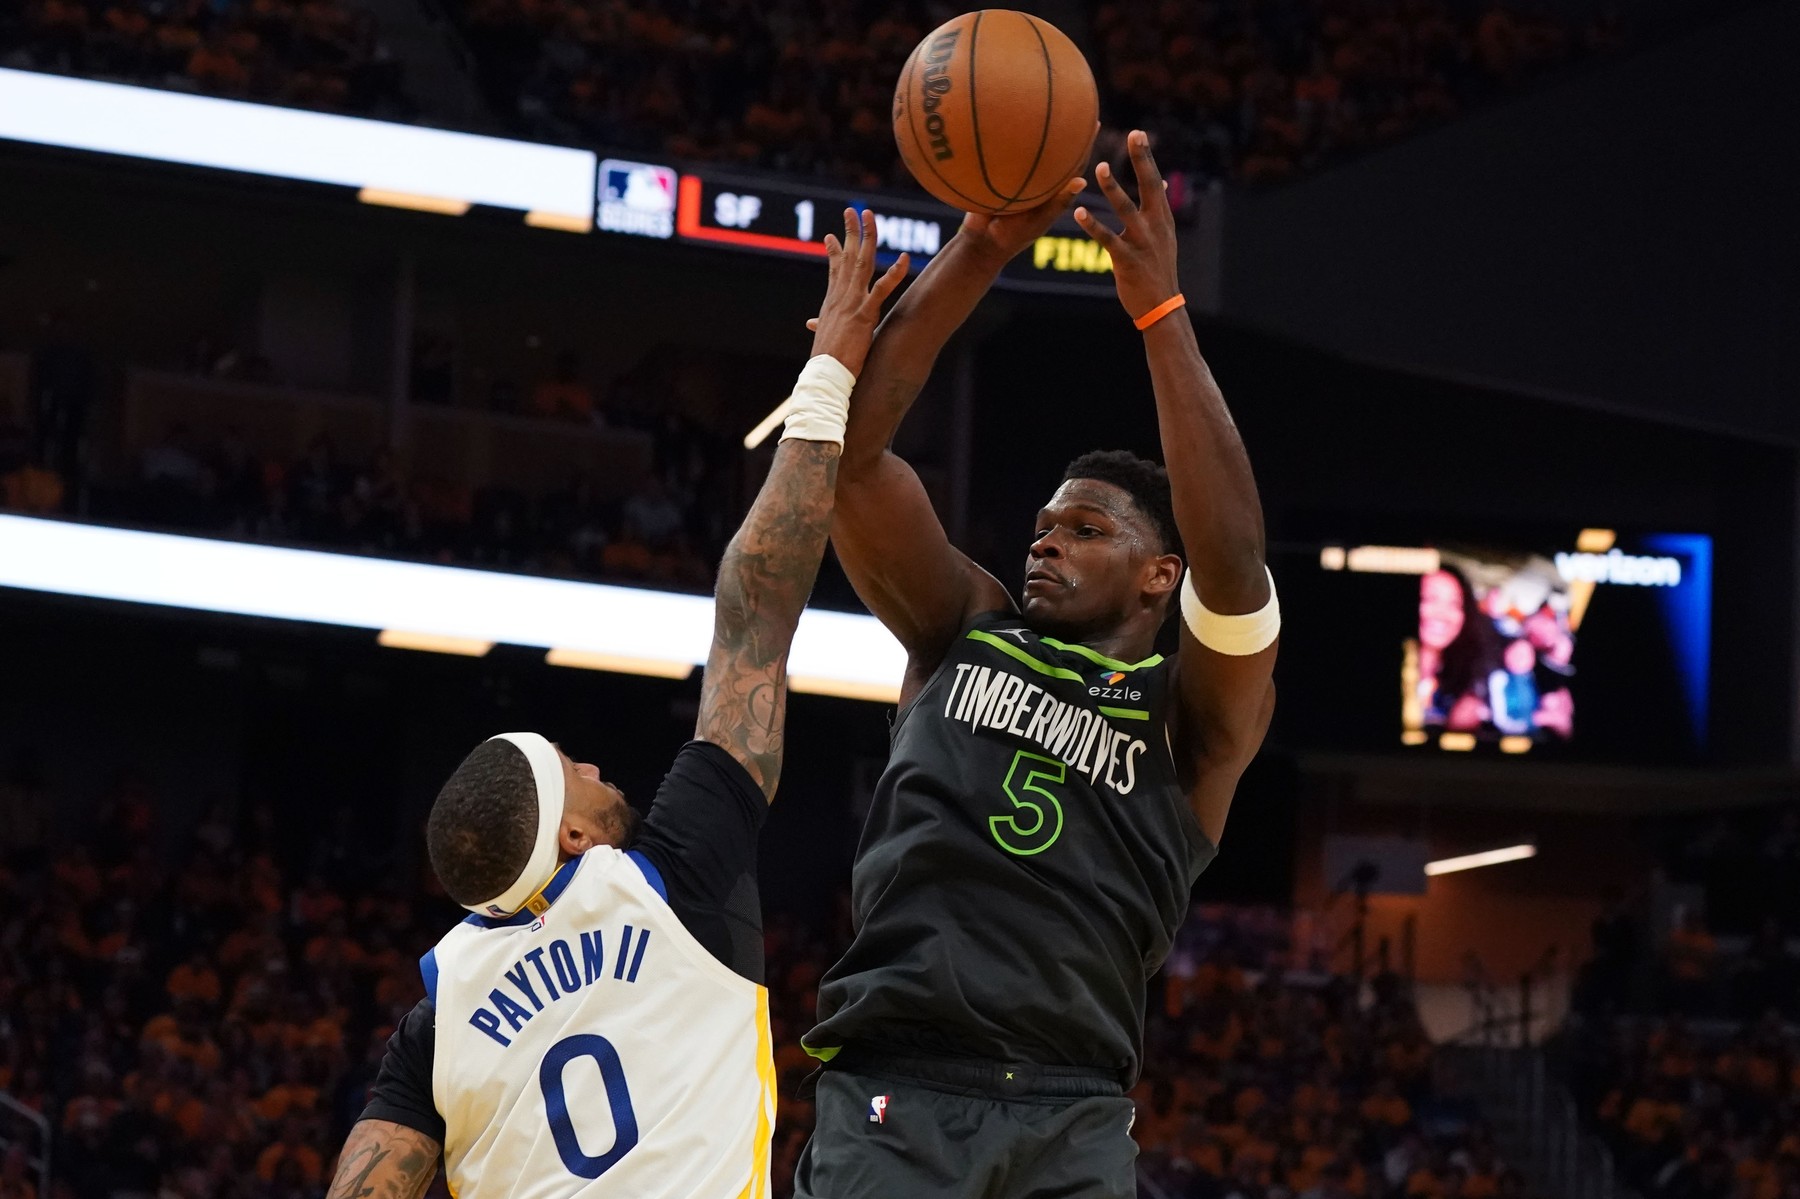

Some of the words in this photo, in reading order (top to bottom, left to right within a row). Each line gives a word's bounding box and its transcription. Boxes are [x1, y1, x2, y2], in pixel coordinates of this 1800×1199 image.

[923, 28, 962, 161] Wilson
[714, 192, 761, 228] SF
[795, 200, 814, 241] 1
[875, 213, 941, 255] MIN
[1034, 236, 1114, 273] FINA
[1555, 548, 1681, 586] verizon
[944, 663, 1147, 795] TIMBERWOLVES
[989, 749, 1066, 855] 5
[468, 929, 604, 1048] PAYTON
[613, 925, 651, 983] II
[539, 1033, 639, 1180] 0
